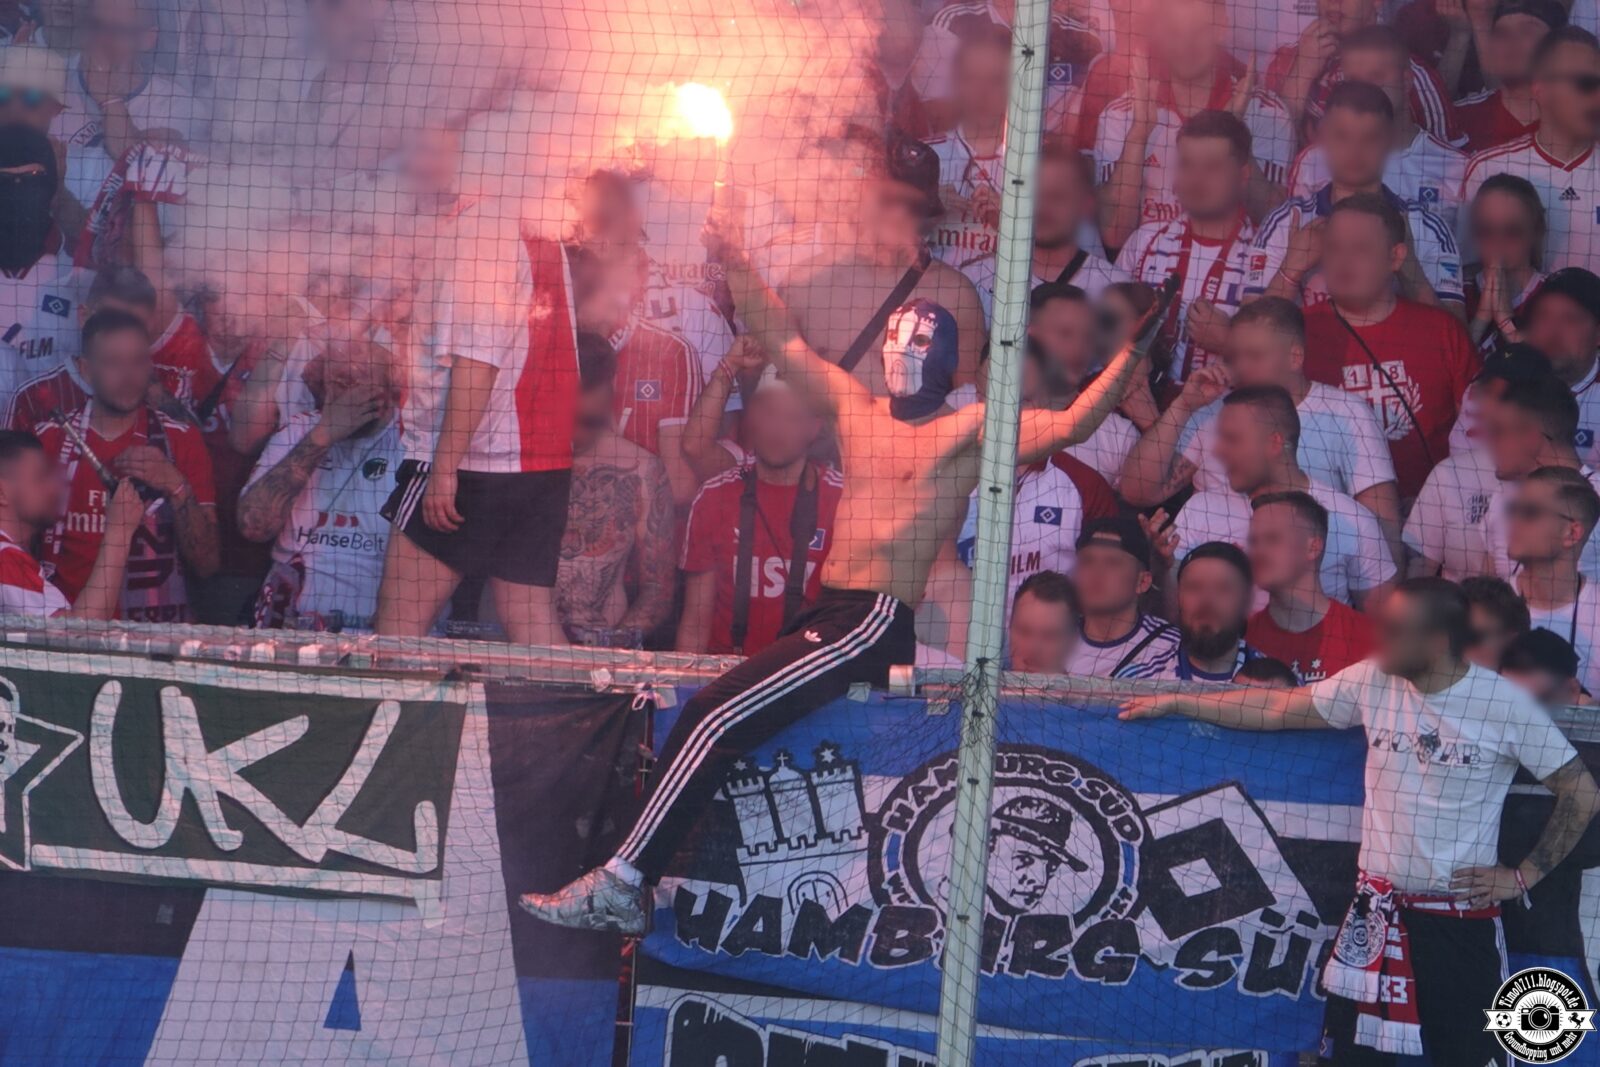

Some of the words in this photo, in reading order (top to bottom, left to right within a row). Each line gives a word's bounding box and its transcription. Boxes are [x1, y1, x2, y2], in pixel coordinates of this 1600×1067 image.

[297, 526, 385, 552] HanseBelt
[1010, 550, 1041, 576] ILM
[882, 752, 1078, 833] HAMURG
[1173, 906, 1328, 1000] SÜ
